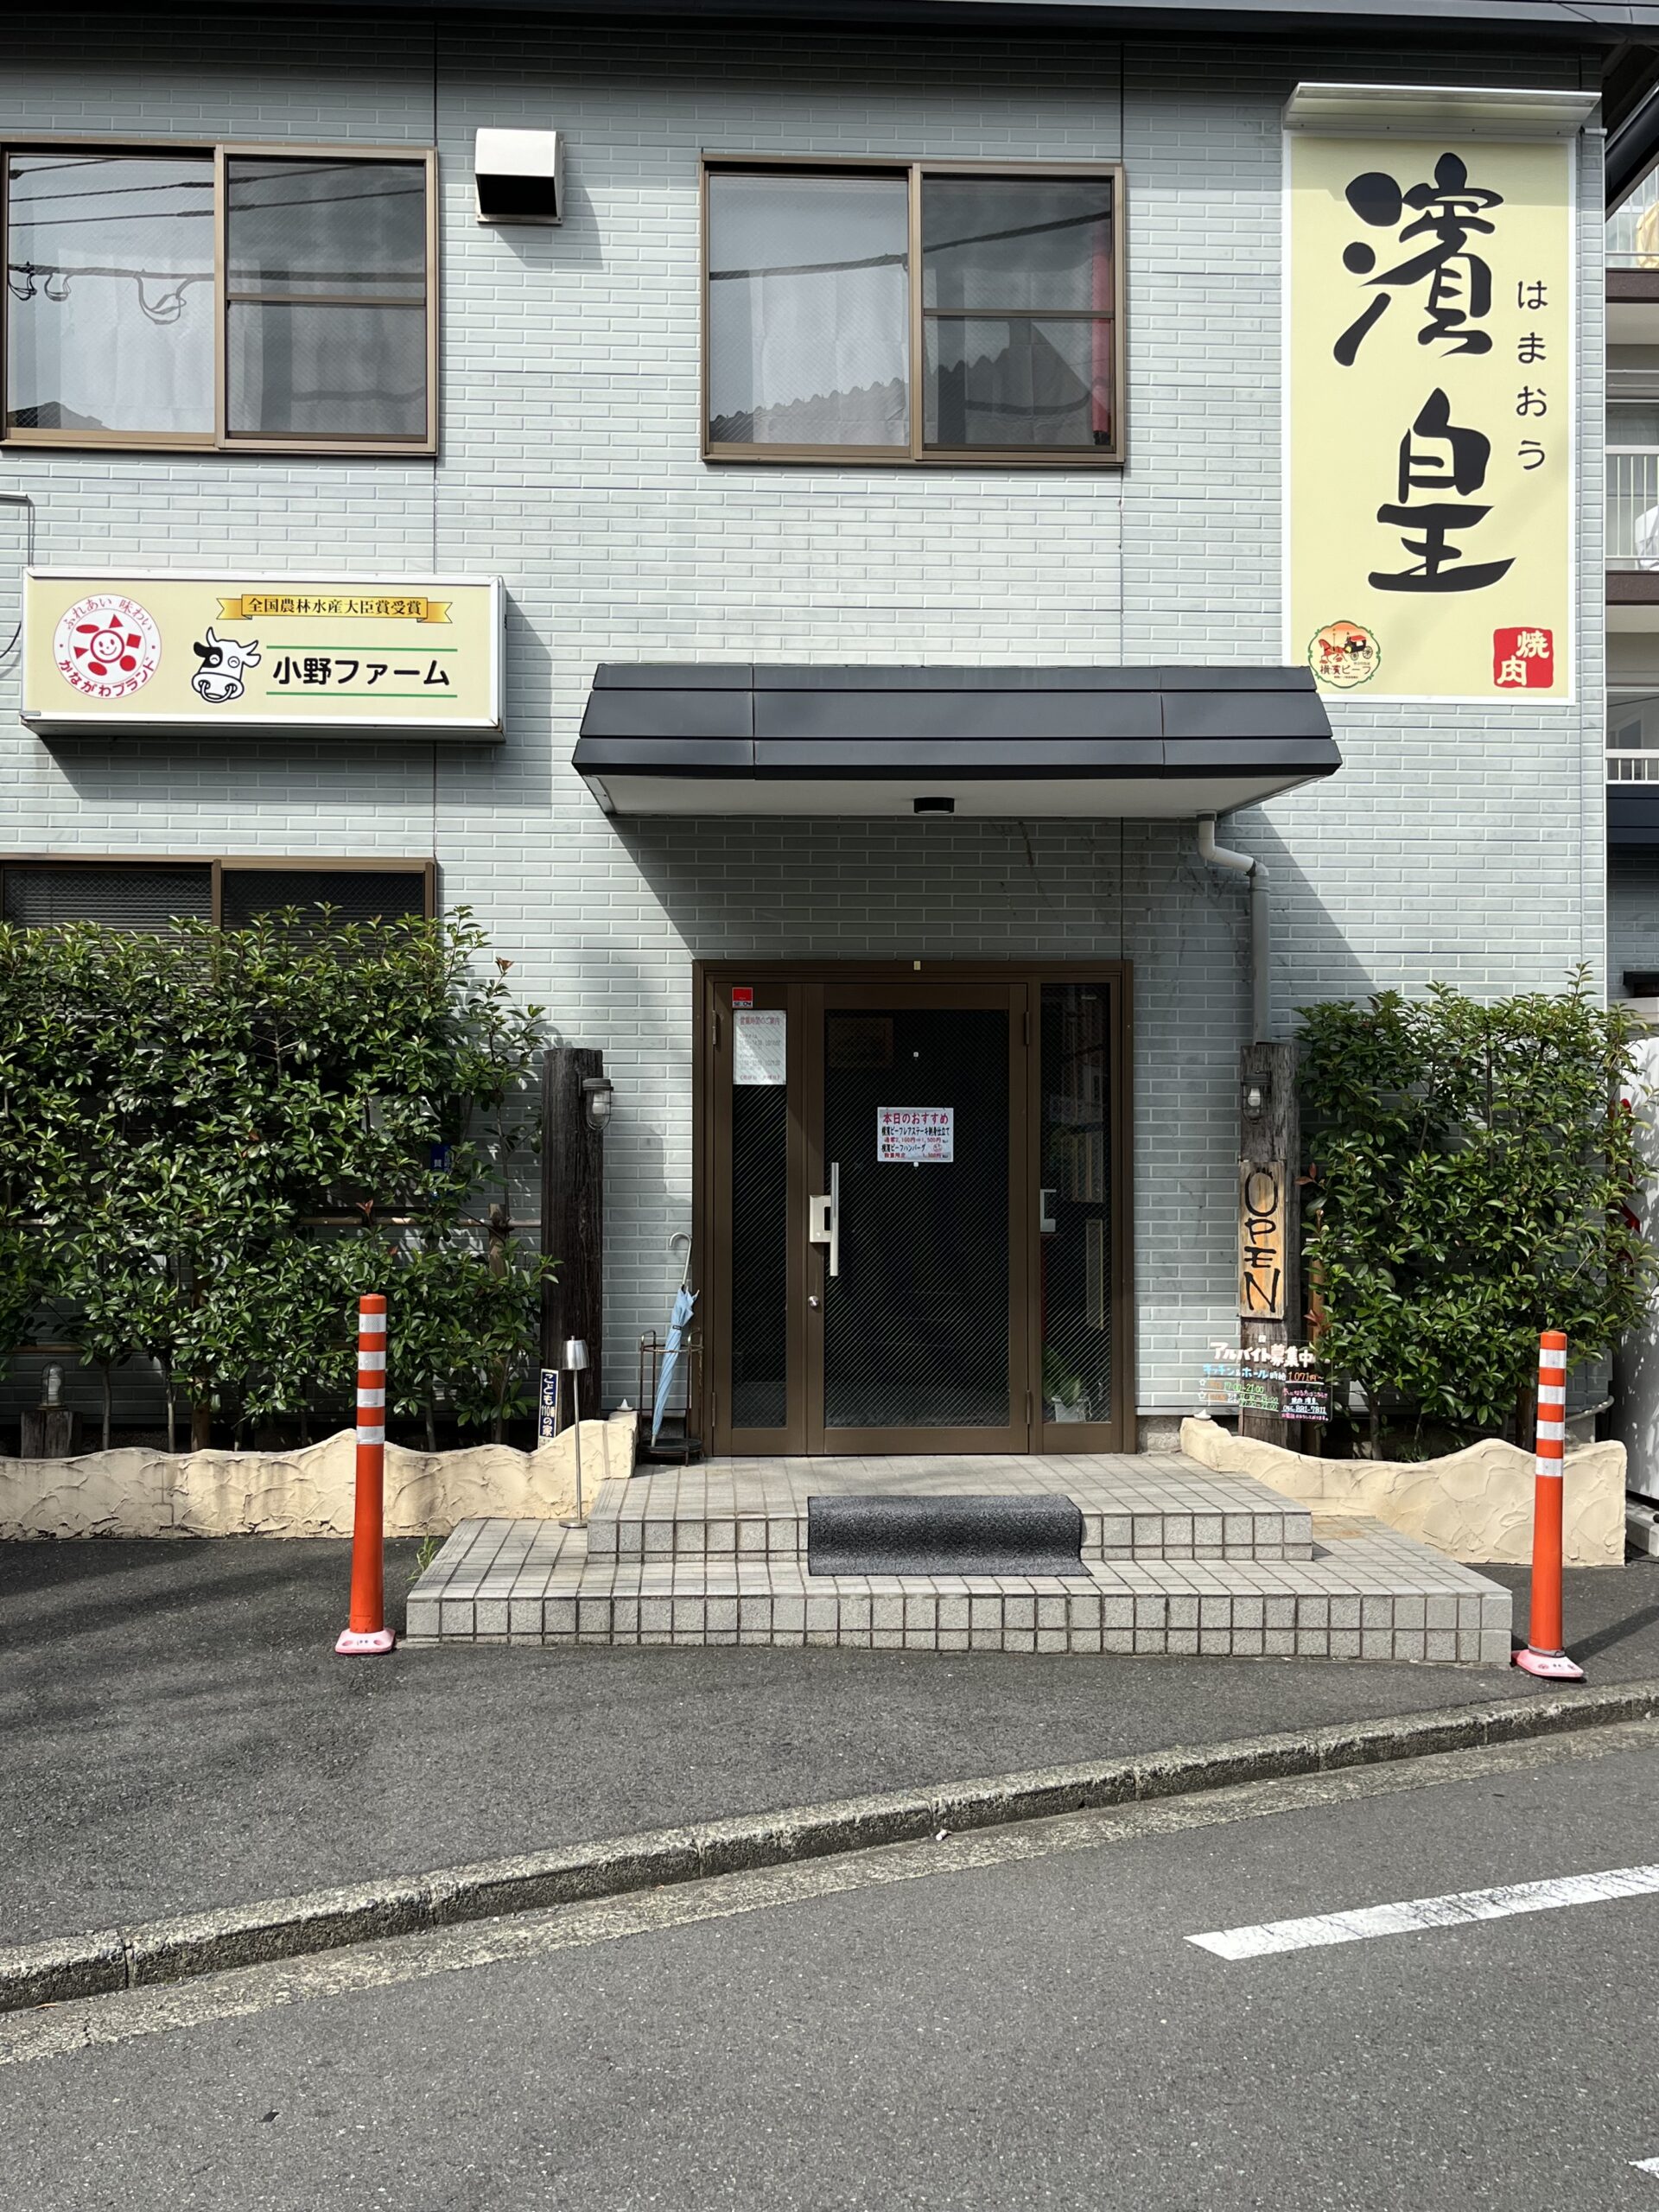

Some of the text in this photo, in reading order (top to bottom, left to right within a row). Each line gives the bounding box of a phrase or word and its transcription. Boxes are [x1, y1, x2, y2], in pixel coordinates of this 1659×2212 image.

[1333, 152, 1517, 593] 濱皇
[1516, 280, 1549, 471] はまおう
[63, 598, 152, 631] ふれあい 味わい
[247, 597, 422, 617] 全国農林水産大臣賞受賞
[58, 657, 155, 697] かながわブランド
[272, 656, 450, 687] 小野ファーム
[1497, 630, 1551, 687] 焼肉
[882, 1112, 949, 1125] 本日のおすすめ
[1244, 1170, 1281, 1313] OPEN
